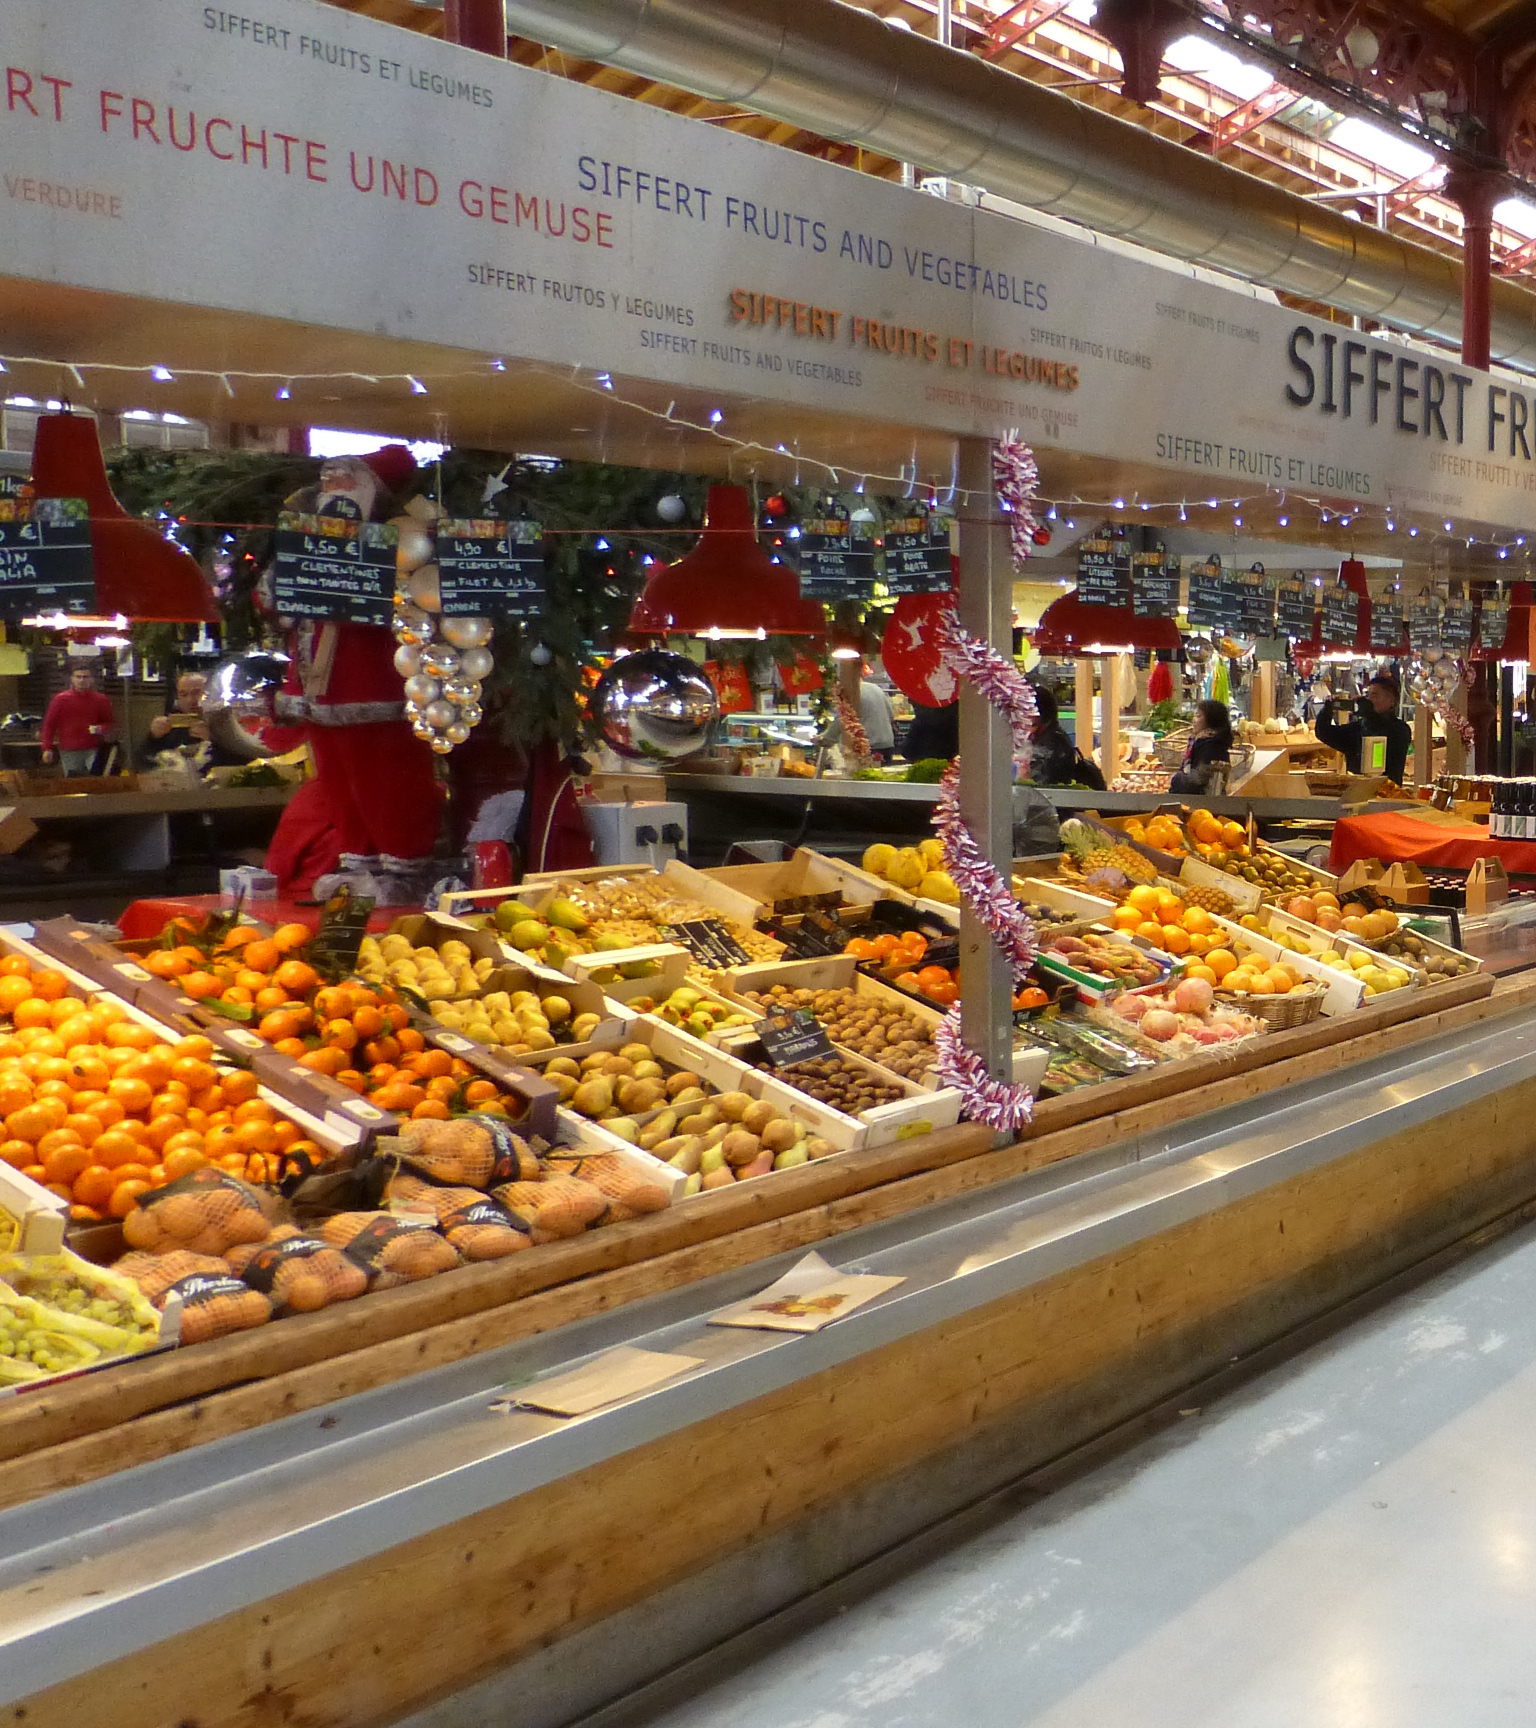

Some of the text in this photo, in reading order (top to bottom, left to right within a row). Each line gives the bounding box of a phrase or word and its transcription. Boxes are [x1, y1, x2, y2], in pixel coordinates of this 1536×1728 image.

[203, 7, 494, 109] SIFFERT FRUITS ET LEGUMES
[4, 66, 616, 249] RT FRUCHTE UND GEMUSE
[2, 173, 123, 220] VERDURE
[578, 156, 1049, 312] SIFFERT FRUITS AND VEGETABLES
[467, 264, 694, 327] SIFFERT FRUTOS Y LEGUMES
[640, 329, 863, 387] SIFFERT FRUITS AND VEGETABLES
[730, 288, 1081, 392] SIFFERT FRUITS ET LEGUMES
[1030, 328, 1152, 370] SIFFERT FRUTOS Y LEGUMES
[1019, 403, 1039, 421] UND
[1041, 408, 1079, 427] GEMUSE
[1284, 325, 1474, 445] SIFFERT
[1156, 433, 1371, 496] SIFFERT FRUITS ET LEGUMES
[1429, 452, 1472, 478] SIFFERT
